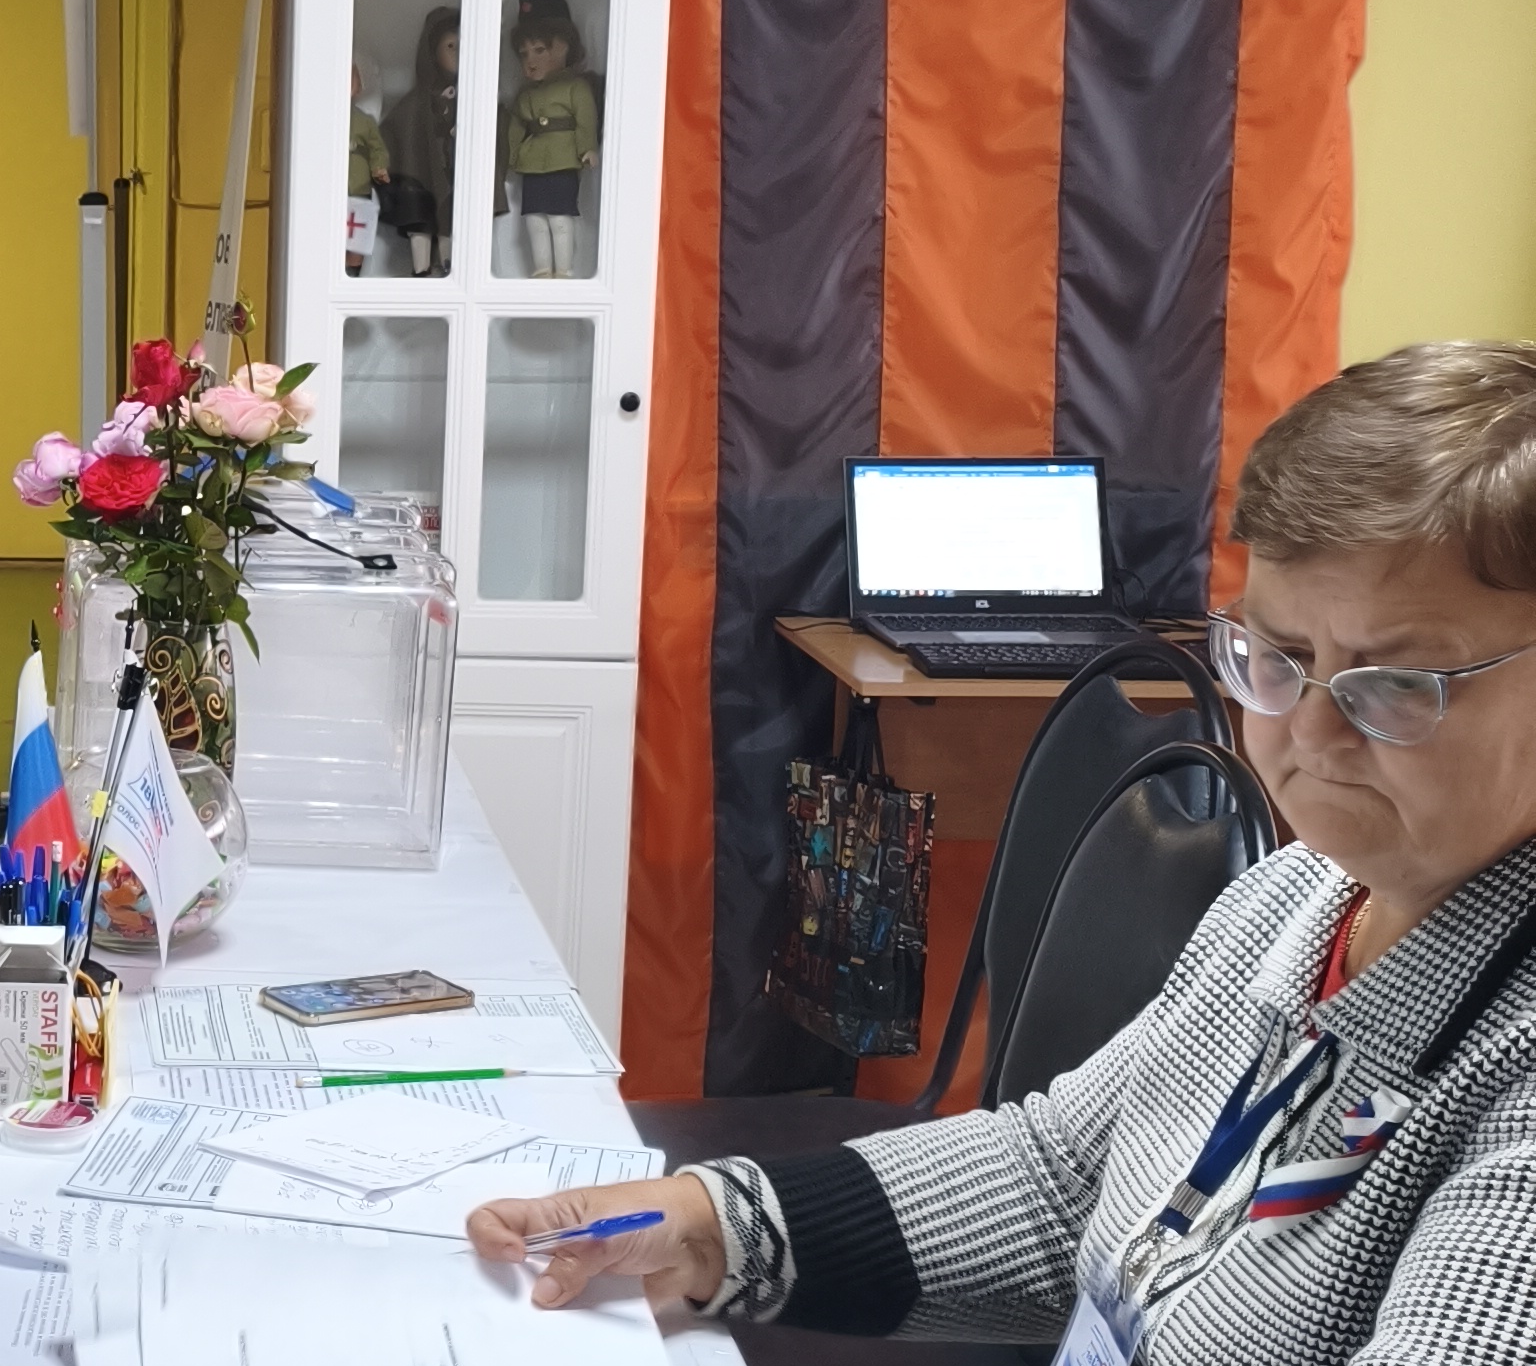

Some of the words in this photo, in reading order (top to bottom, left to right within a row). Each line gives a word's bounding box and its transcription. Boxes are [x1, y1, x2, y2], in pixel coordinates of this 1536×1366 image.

[139, 776, 152, 803] 18
[19, 990, 28, 1018] Скрепки
[20, 1020, 27, 1030] 50
[40, 990, 57, 1055] STAFF
[20, 1032, 25, 1043] мм
